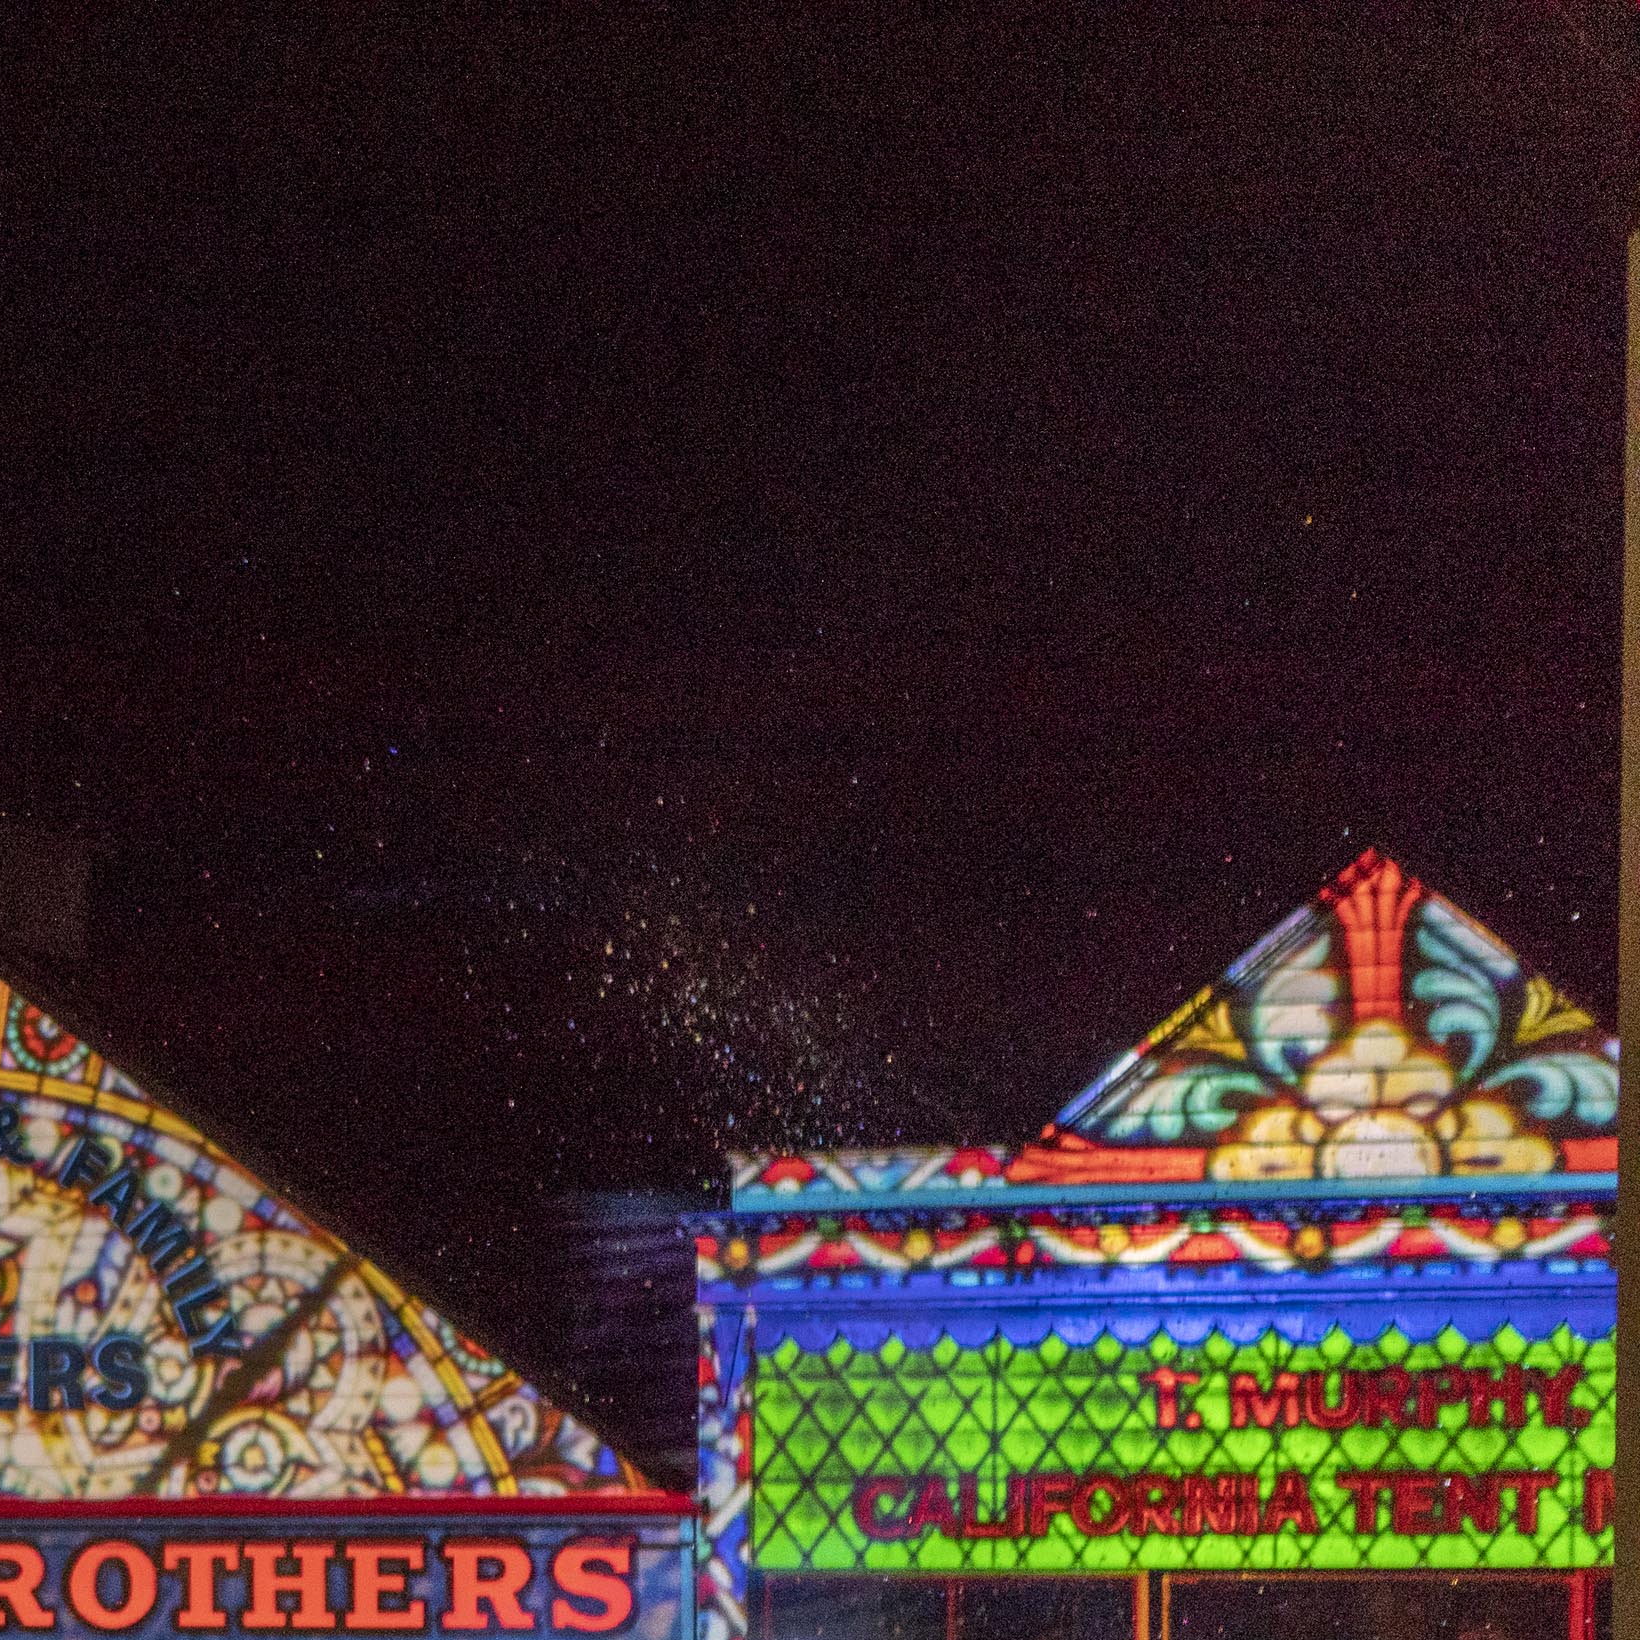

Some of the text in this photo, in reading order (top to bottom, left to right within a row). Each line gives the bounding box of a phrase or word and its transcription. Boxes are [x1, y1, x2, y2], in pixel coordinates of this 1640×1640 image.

[58, 1138, 242, 1360] FAMILY
[853, 1474, 1317, 1538] CALIFORNIA
[1337, 1471, 1558, 1534] TENT
